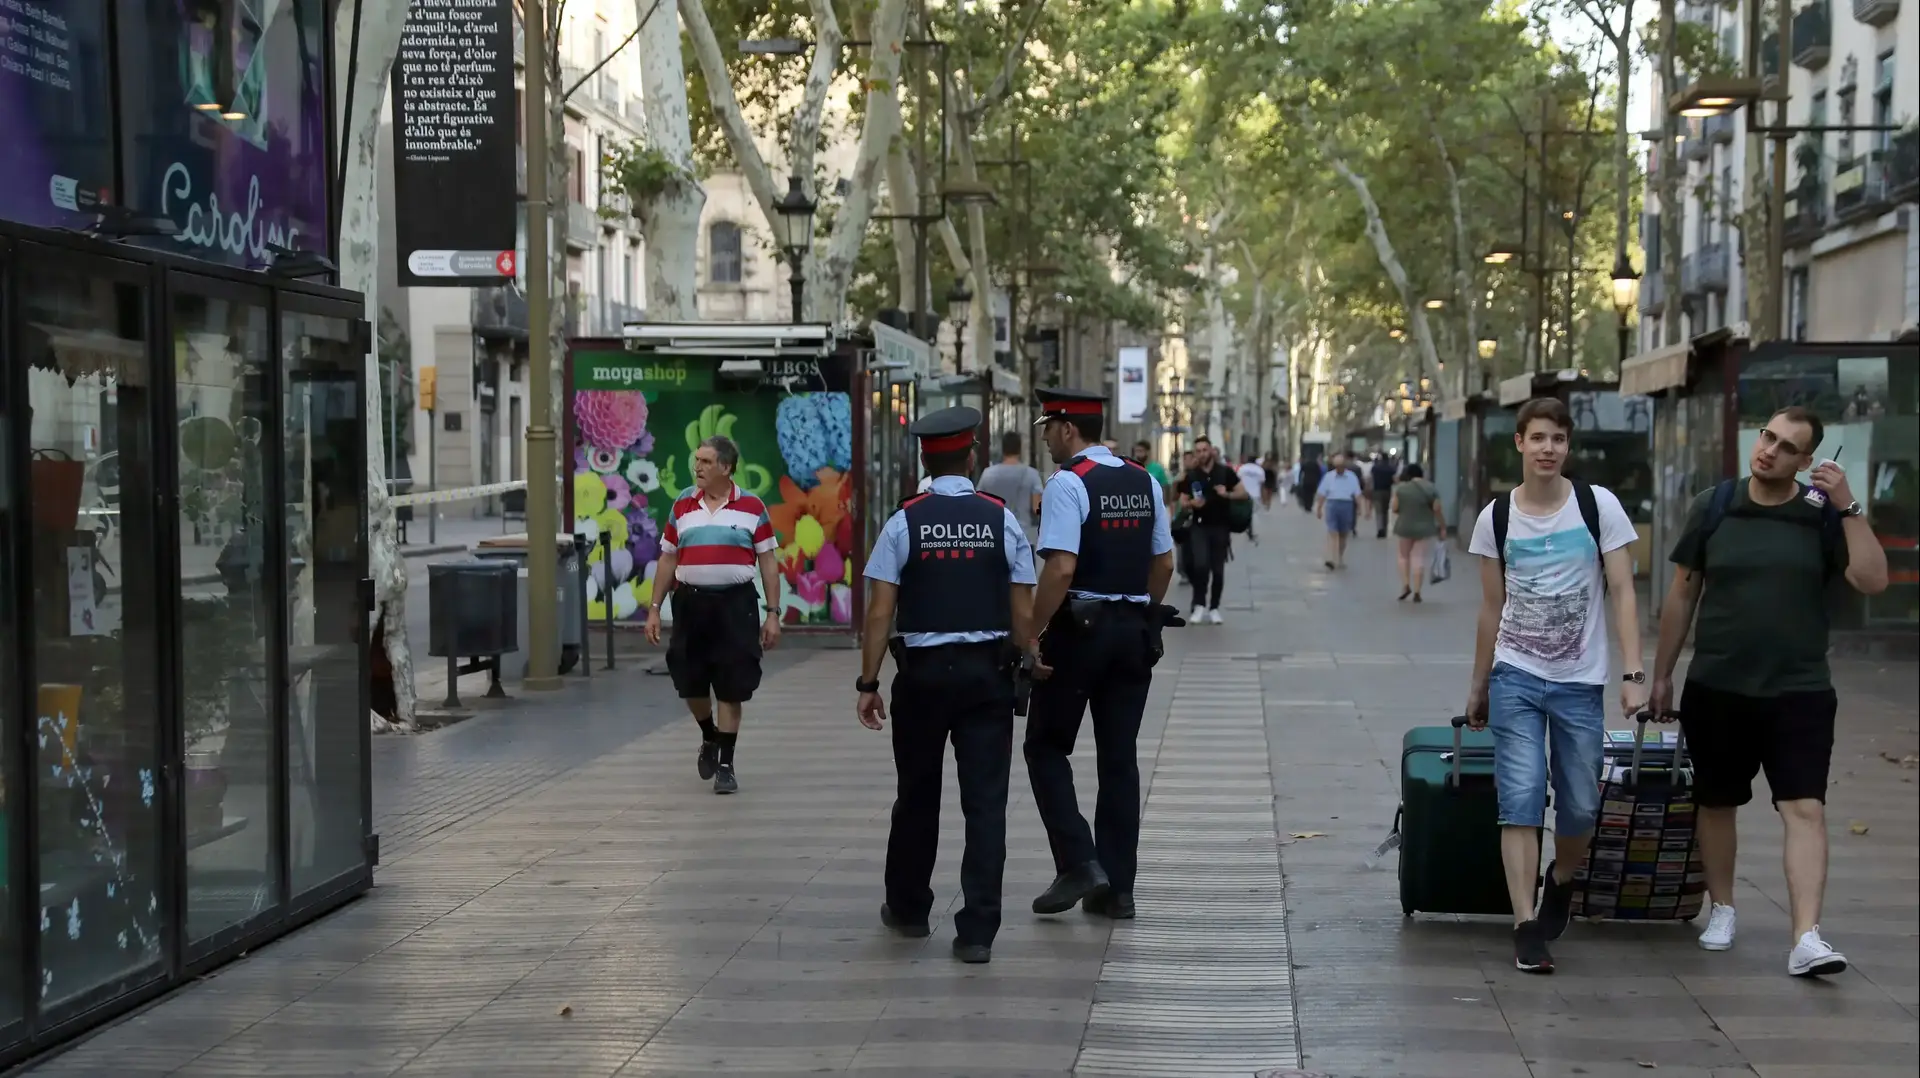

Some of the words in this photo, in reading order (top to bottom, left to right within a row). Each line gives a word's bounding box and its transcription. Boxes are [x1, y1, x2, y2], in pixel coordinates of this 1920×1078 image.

[415, 8, 446, 20] d'una
[449, 8, 483, 20] foscor
[464, 22, 498, 33] d'arrel
[402, 35, 456, 46] adormida
[459, 37, 472, 46] en
[475, 35, 486, 46] la
[402, 50, 426, 60] seva
[429, 48, 461, 62] força,
[464, 48, 497, 60] d'olor
[403, 63, 422, 75] que
[425, 63, 438, 72] no
[440, 61, 450, 72] té
[453, 61, 496, 74] perfum.
[403, 74, 409, 85] I
[411, 76, 425, 85] en
[428, 76, 445, 85] res
[404, 90, 418, 99] no
[419, 87, 463, 99] existeix
[465, 87, 475, 99] el
[477, 90, 497, 101] que
[404, 100, 415, 111] és
[418, 100, 470, 111] abstracte.
[404, 112, 415, 124] la
[417, 113, 441, 126] part
[443, 112, 495, 127] figurativa
[437, 128, 458, 140] que
[460, 126, 472, 137] és
[593, 362, 686, 386] moyashop
[1100, 494, 1151, 510] POLICIA
[920, 523, 994, 540] POLICIA
